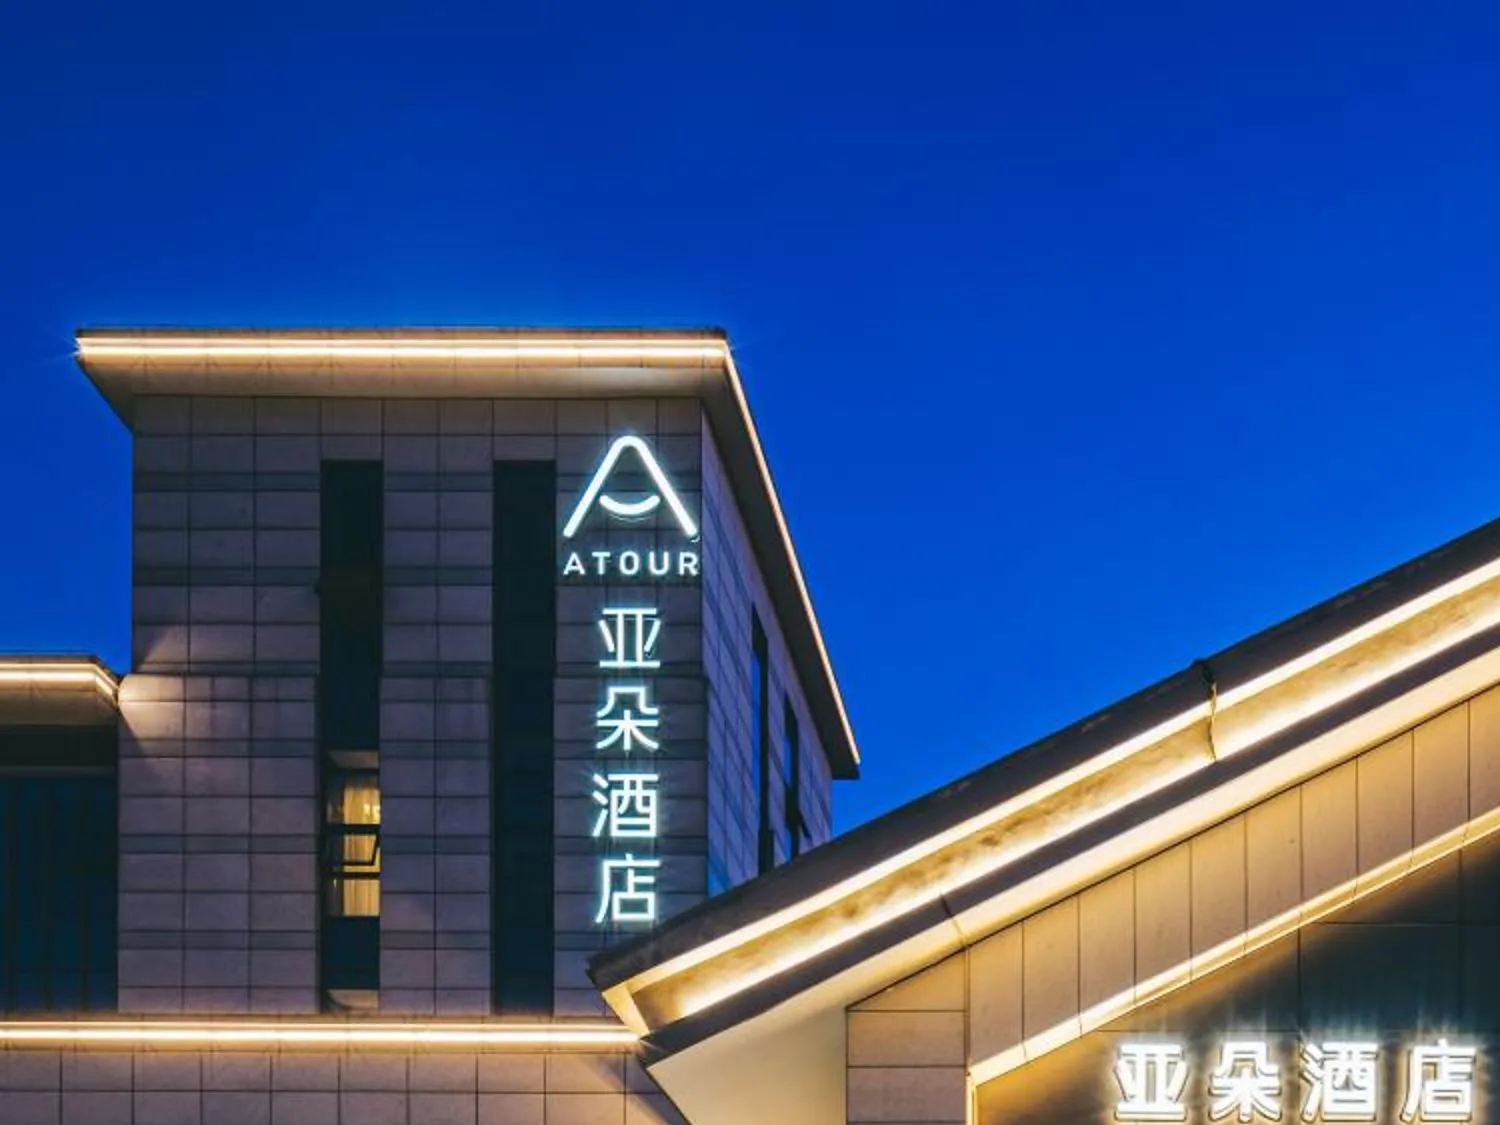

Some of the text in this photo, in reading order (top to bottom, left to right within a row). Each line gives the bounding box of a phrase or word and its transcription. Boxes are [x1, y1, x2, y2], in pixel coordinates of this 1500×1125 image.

[563, 551, 699, 576] ATOUR
[592, 607, 662, 924] 亚朵酒店
[1113, 1039, 1478, 1124] 亚朵酒店
